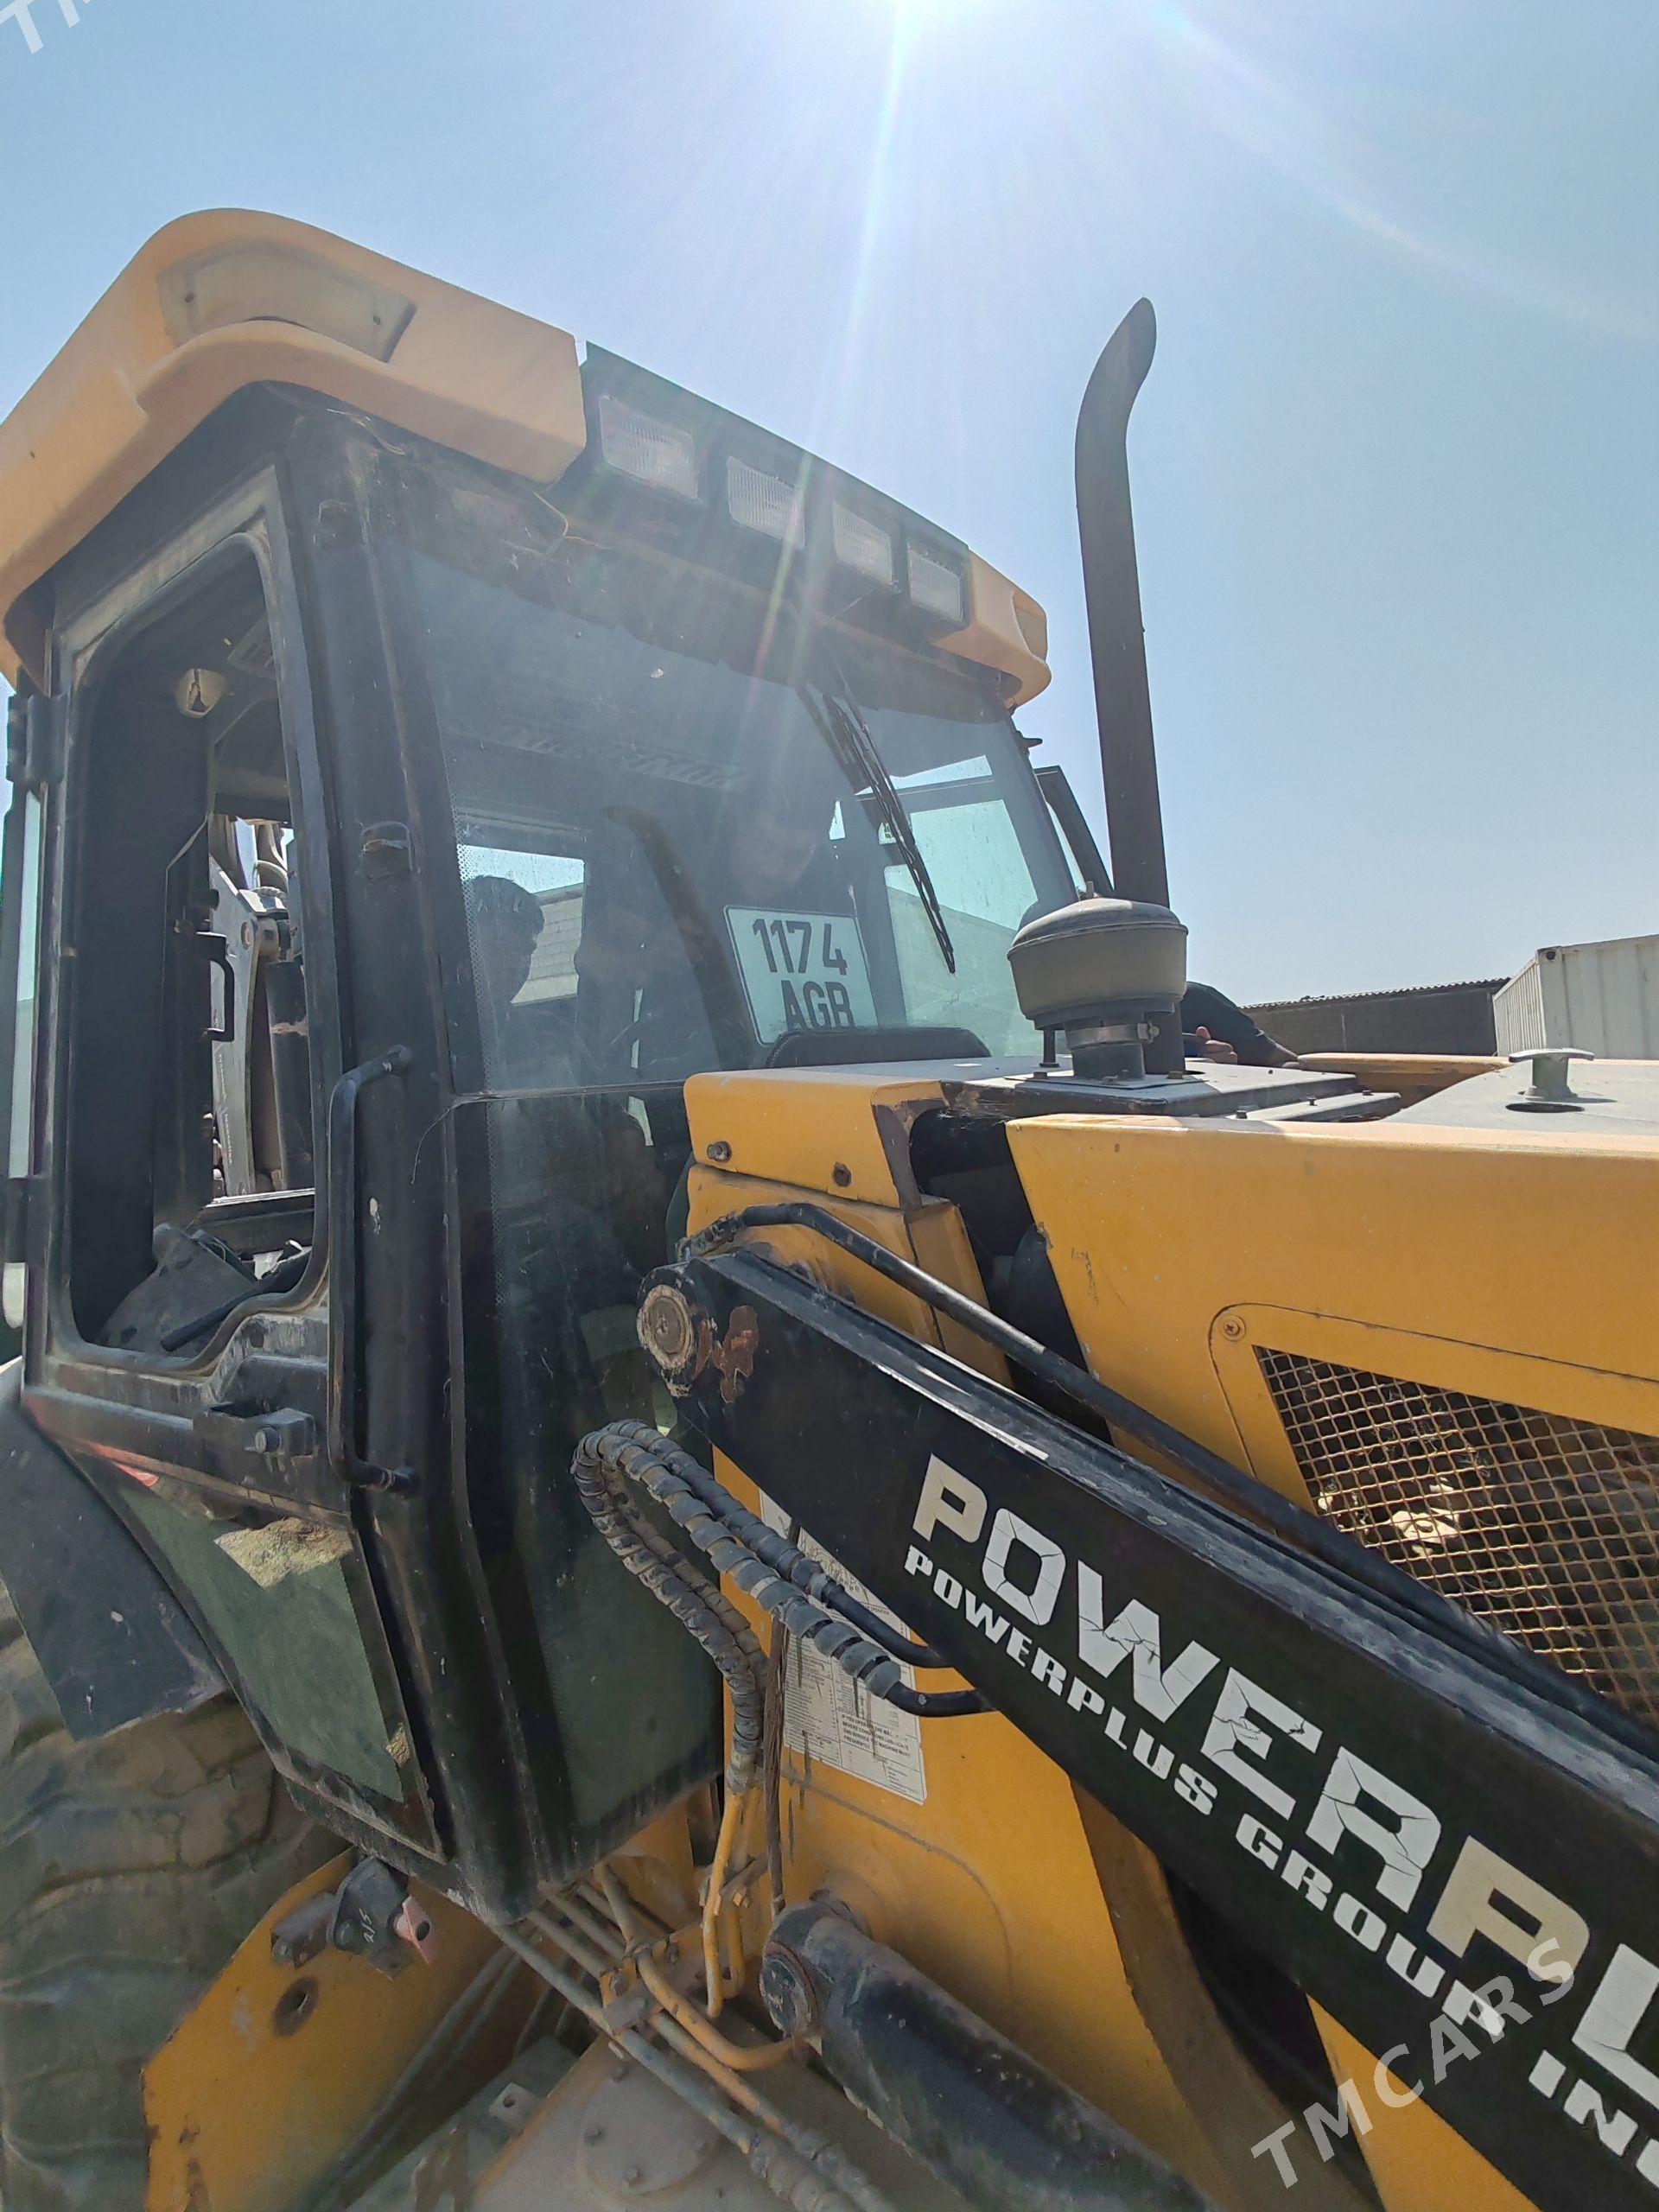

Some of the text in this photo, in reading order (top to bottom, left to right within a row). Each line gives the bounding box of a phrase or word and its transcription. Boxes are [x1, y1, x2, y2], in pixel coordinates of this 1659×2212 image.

[753, 918, 848, 976] 1174
[904, 1545, 1218, 1815] POWERPLUS
[1236, 1813, 1506, 2037] GROUP
